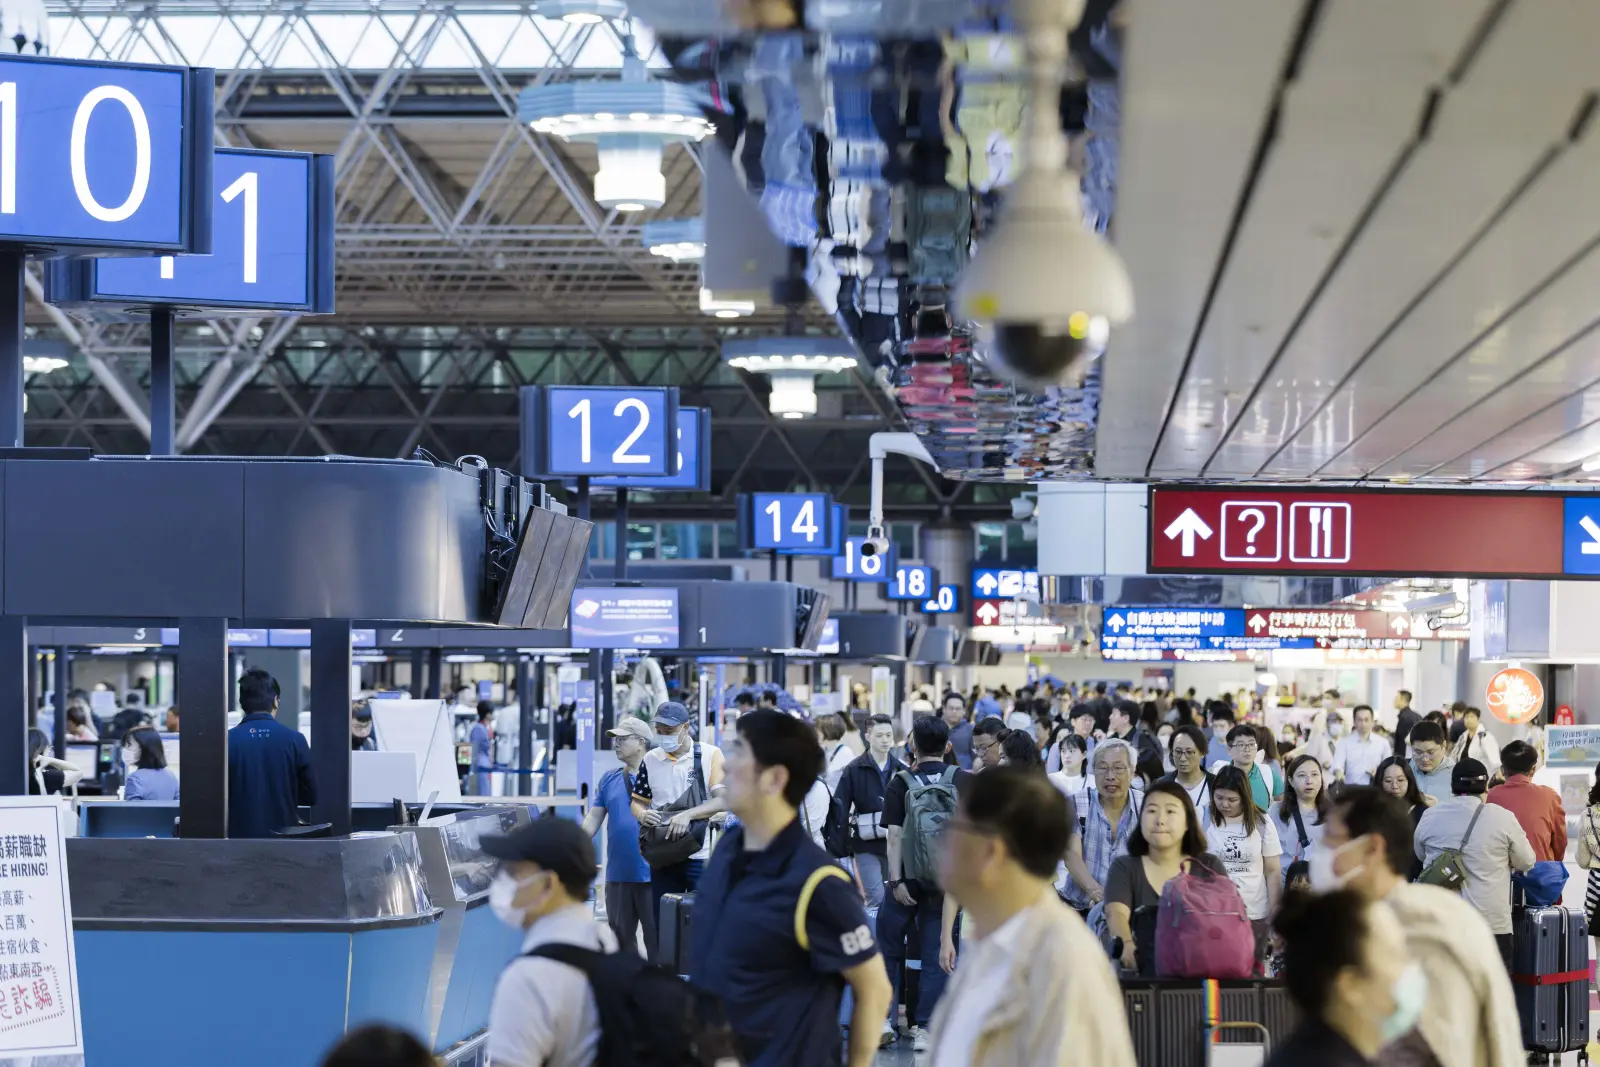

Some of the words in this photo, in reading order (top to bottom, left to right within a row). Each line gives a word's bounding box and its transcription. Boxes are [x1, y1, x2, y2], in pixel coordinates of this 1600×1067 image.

[0, 82, 151, 222] 10
[160, 171, 258, 283] 1
[568, 398, 650, 463] 12
[765, 500, 819, 542] 14
[896, 569, 925, 597] 18
[698, 627, 707, 644] 1
[10, 862, 49, 878] HIRING!
